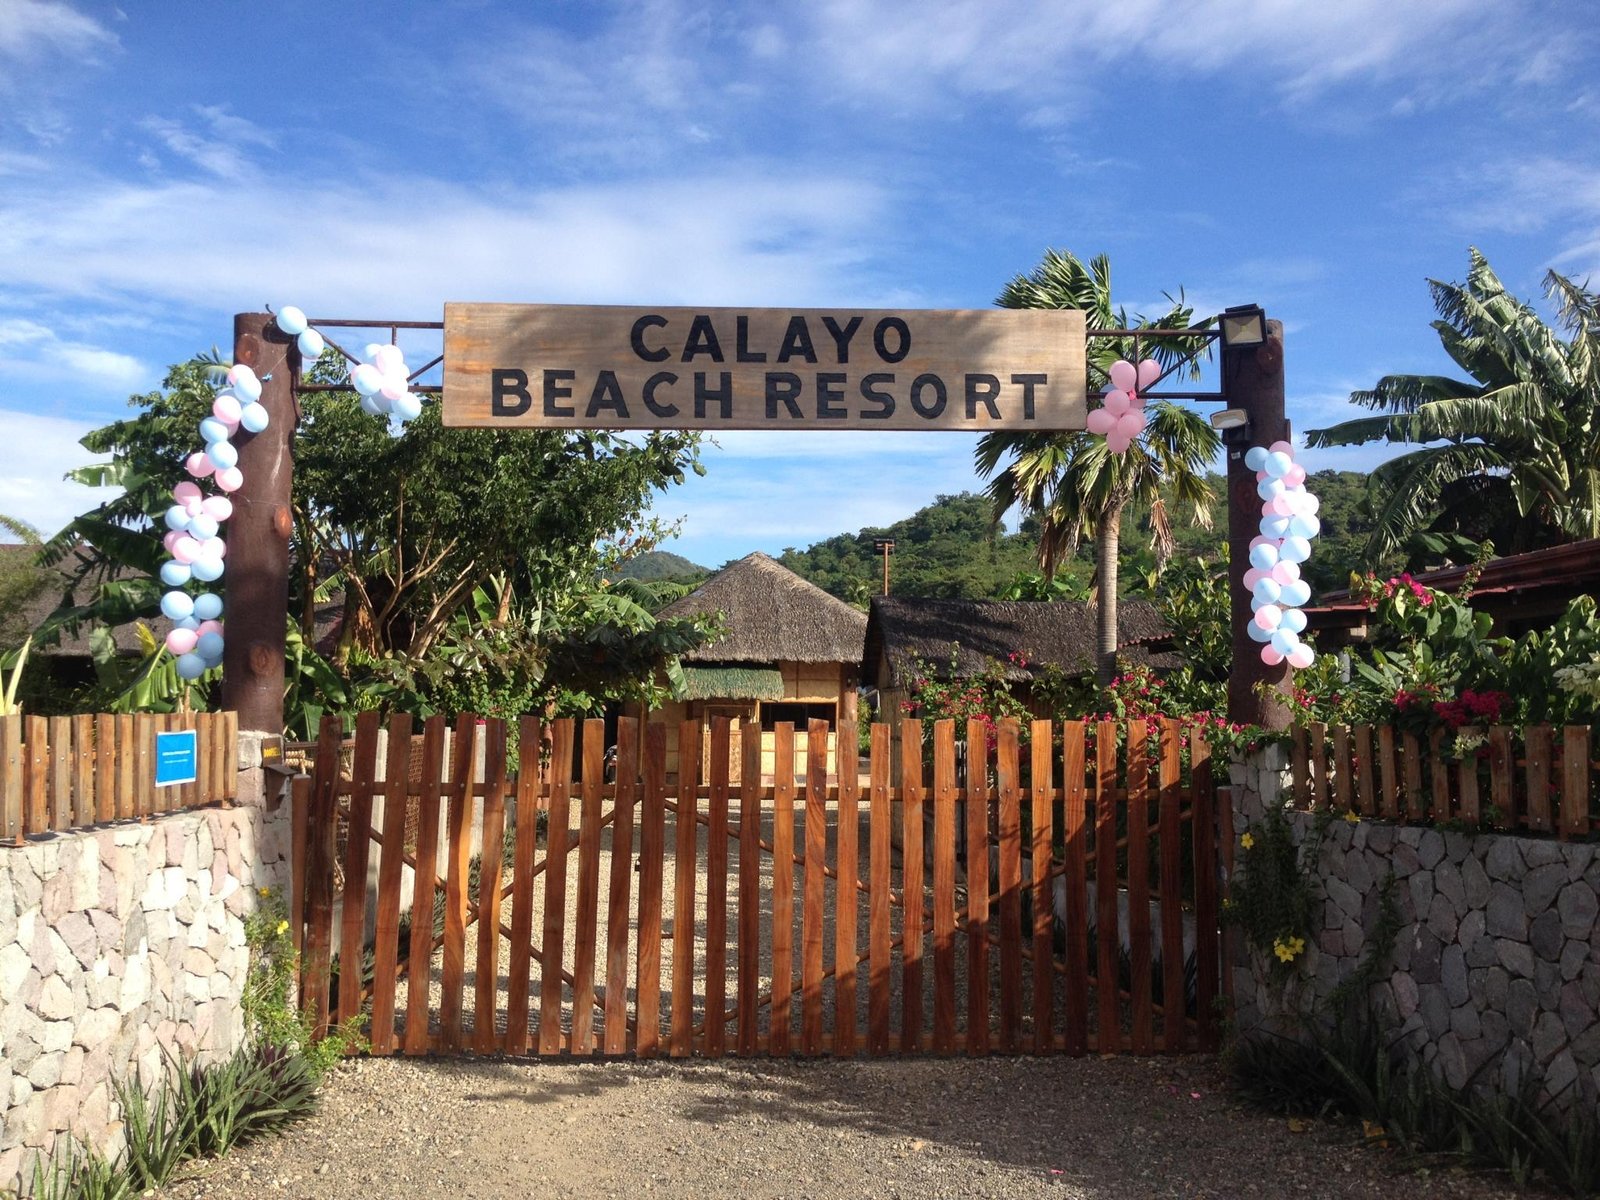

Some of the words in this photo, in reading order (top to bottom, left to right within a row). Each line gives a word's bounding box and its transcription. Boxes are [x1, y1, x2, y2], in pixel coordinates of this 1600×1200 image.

[630, 314, 911, 364] CALAYO
[491, 368, 733, 419] BEACH
[765, 371, 1048, 420] RESORT
